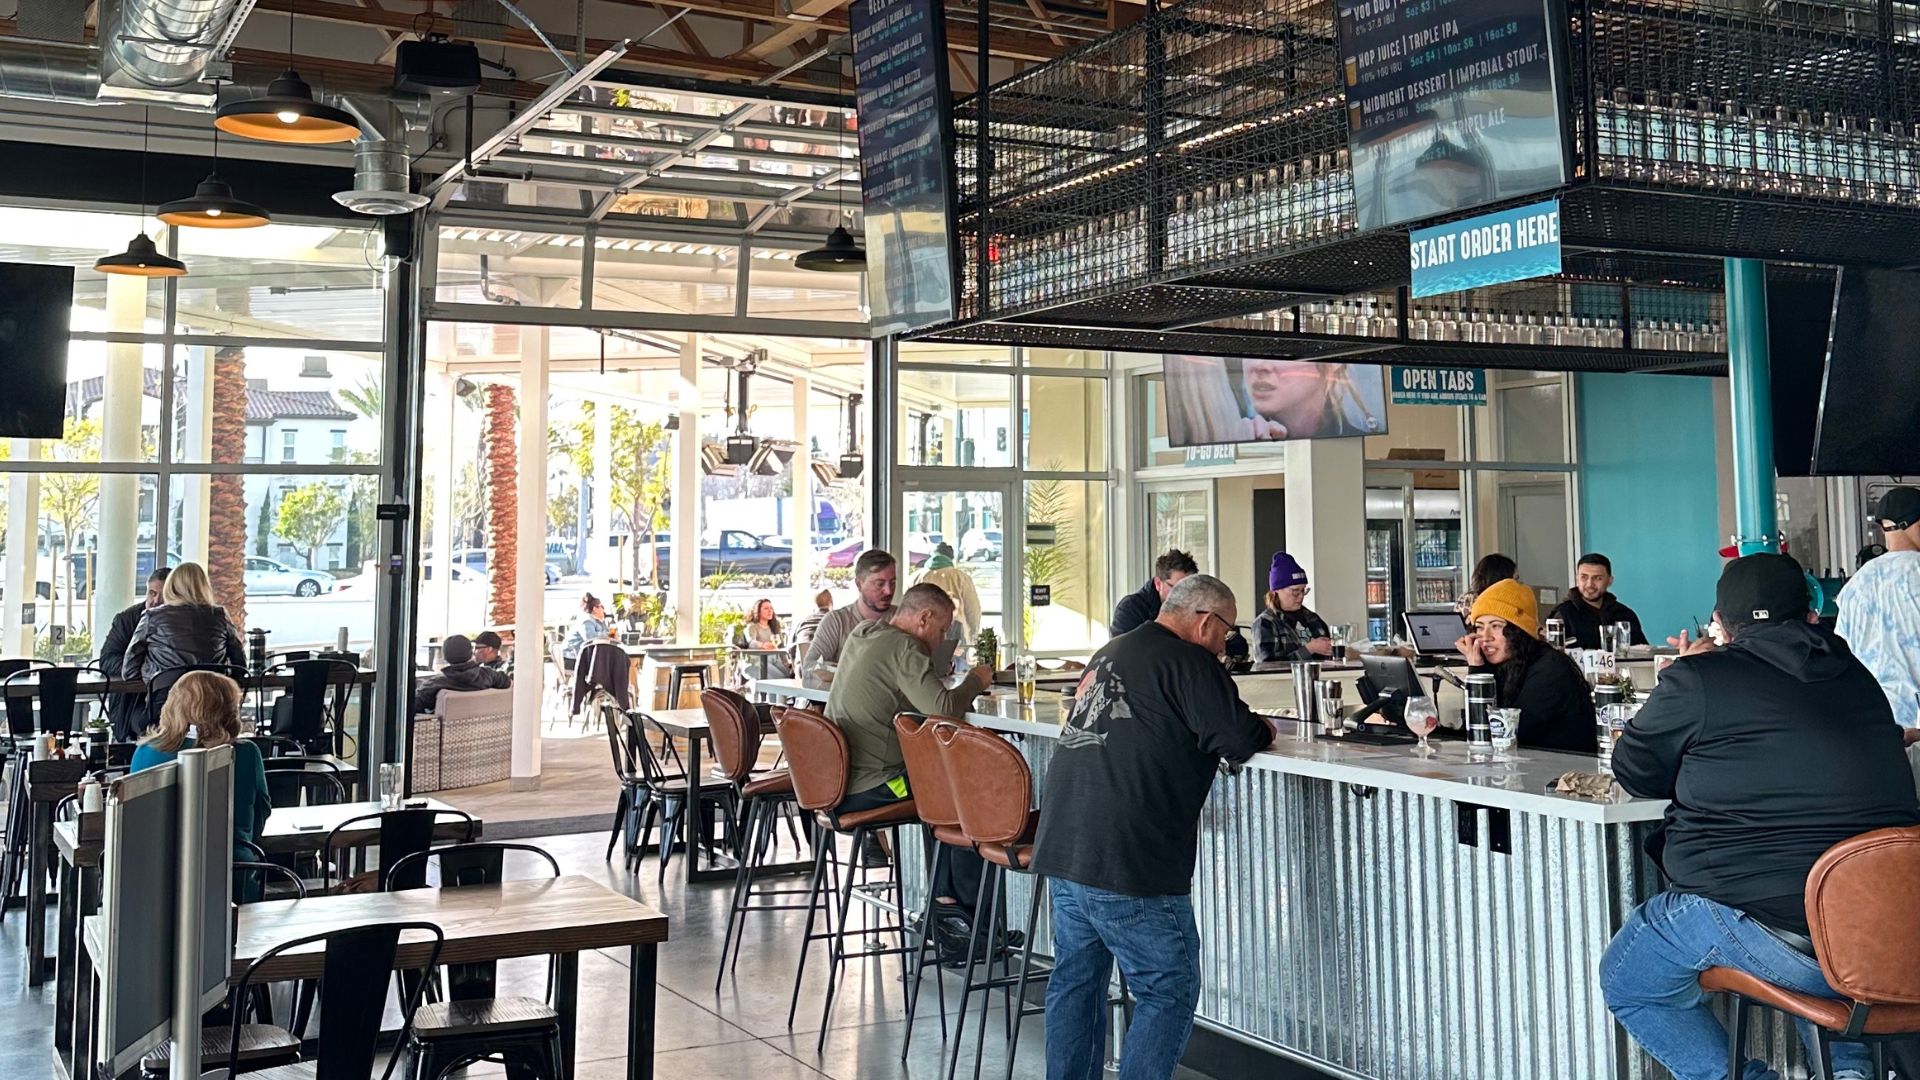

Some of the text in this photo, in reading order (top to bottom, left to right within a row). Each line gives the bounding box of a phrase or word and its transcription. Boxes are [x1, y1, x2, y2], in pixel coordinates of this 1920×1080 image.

[1353, 2, 1371, 21] YOO
[1358, 19, 1459, 69] HOP JUICE TRIPLE IPA
[1362, 43, 1539, 115] MIDNIGHT DESSERT IMPERIAL STOUT
[1487, 107, 1506, 128] ALE
[1410, 211, 1559, 270] START ORDER HERE
[1402, 368, 1474, 391] OPEN TABS
[56, 627, 63, 640] 2
